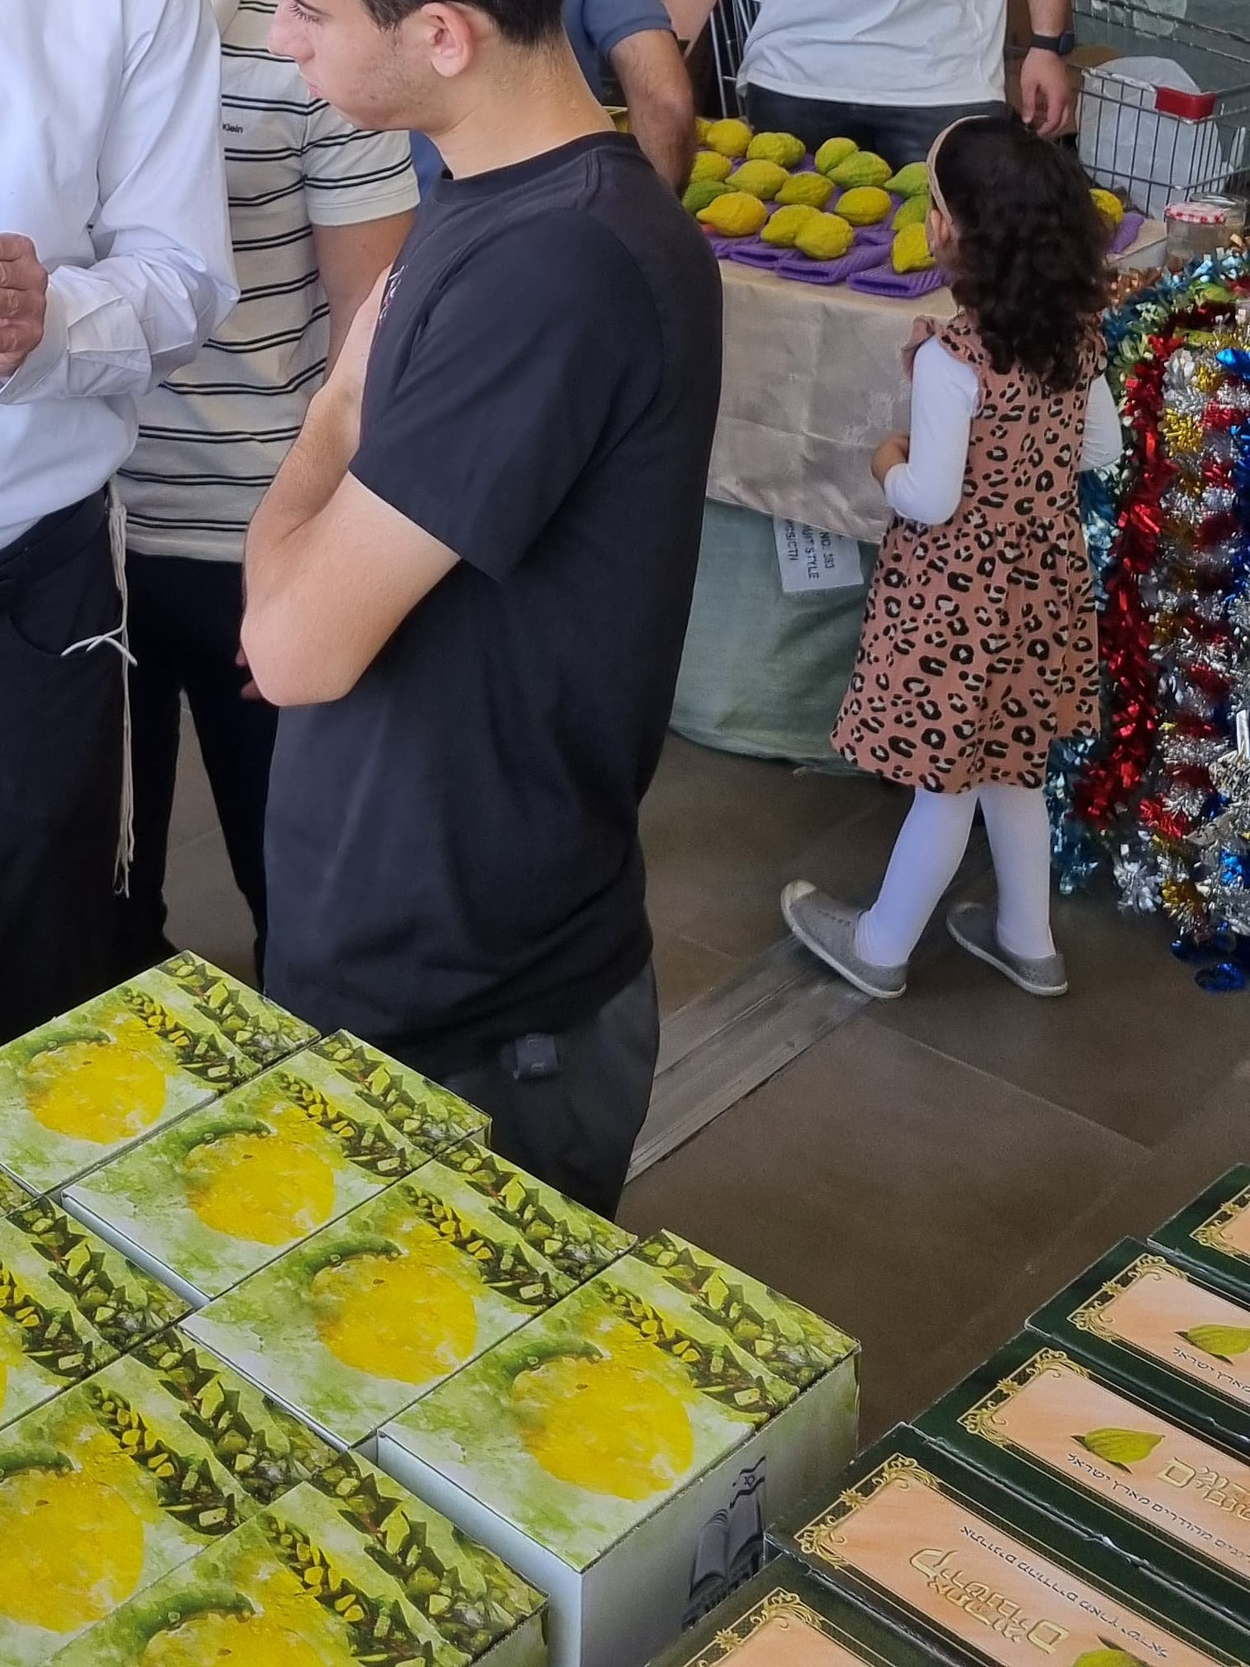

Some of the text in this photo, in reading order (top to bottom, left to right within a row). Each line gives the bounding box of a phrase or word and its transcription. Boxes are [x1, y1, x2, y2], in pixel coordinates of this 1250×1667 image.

[805, 547, 819, 580] STYLE
[1172, 1346, 1215, 1372] ישראל
[1067, 1453, 1111, 1484] ישראל
[1111, 1480, 1151, 1509] מארץ
[1152, 1502, 1213, 1541] מהודרים
[910, 1547, 1070, 1656] קירשנבוים
[928, 1574, 1025, 1645] אתרוגי
[960, 1525, 1168, 1660] אתרוגים מהודרים מארץ ישראל
